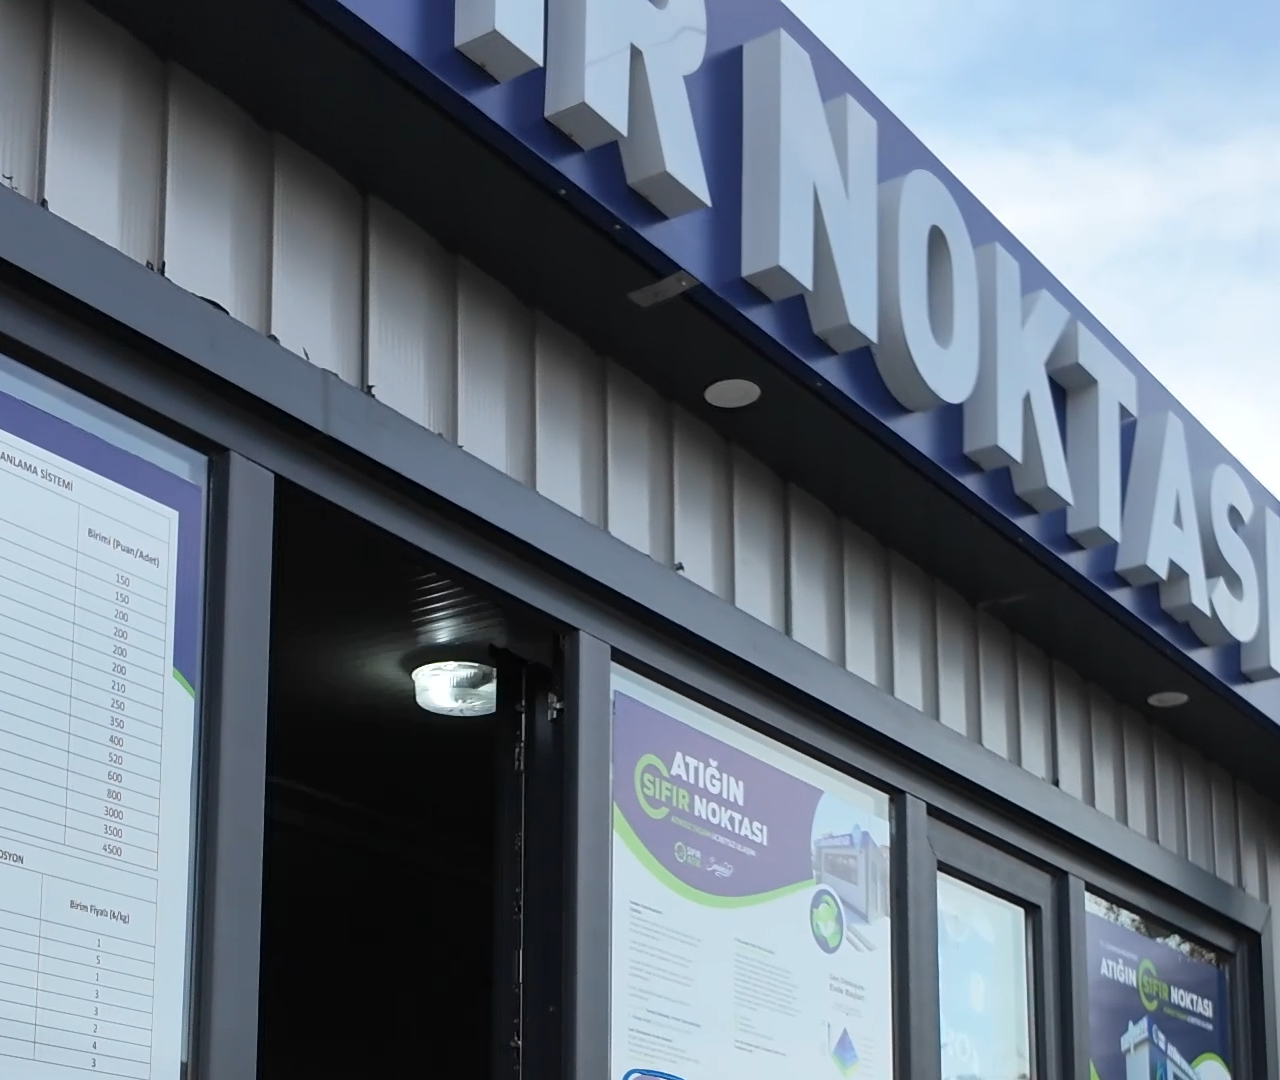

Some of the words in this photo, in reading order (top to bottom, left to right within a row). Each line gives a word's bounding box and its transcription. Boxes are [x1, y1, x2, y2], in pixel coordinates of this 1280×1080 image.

[40, 468, 74, 492] SİSTEMİ
[87, 527, 111, 546] Birimi
[112, 538, 160, 569] (Puan/Adet)
[116, 573, 130, 587] 150
[115, 591, 130, 605] 150
[114, 609, 129, 622] 200
[113, 626, 128, 640] 200
[112, 644, 127, 658] 200
[112, 662, 127, 676] 200
[111, 680, 126, 693] 210
[110, 698, 125, 711] 250
[109, 716, 125, 730] 350
[108, 734, 124, 748] 400
[108, 752, 123, 766] 520
[107, 770, 122, 783] 600
[670, 751, 744, 807] ATIĞIN
[107, 788, 122, 801] 800
[104, 806, 124, 821] 3000
[642, 774, 690, 812] SIFIR
[694, 794, 767, 846] NOKTASI
[103, 824, 123, 838] 3500
[102, 843, 122, 857] 4500
[1100, 957, 1137, 989] ATIĞIN
[1170, 985, 1213, 1019] NOKTASI
